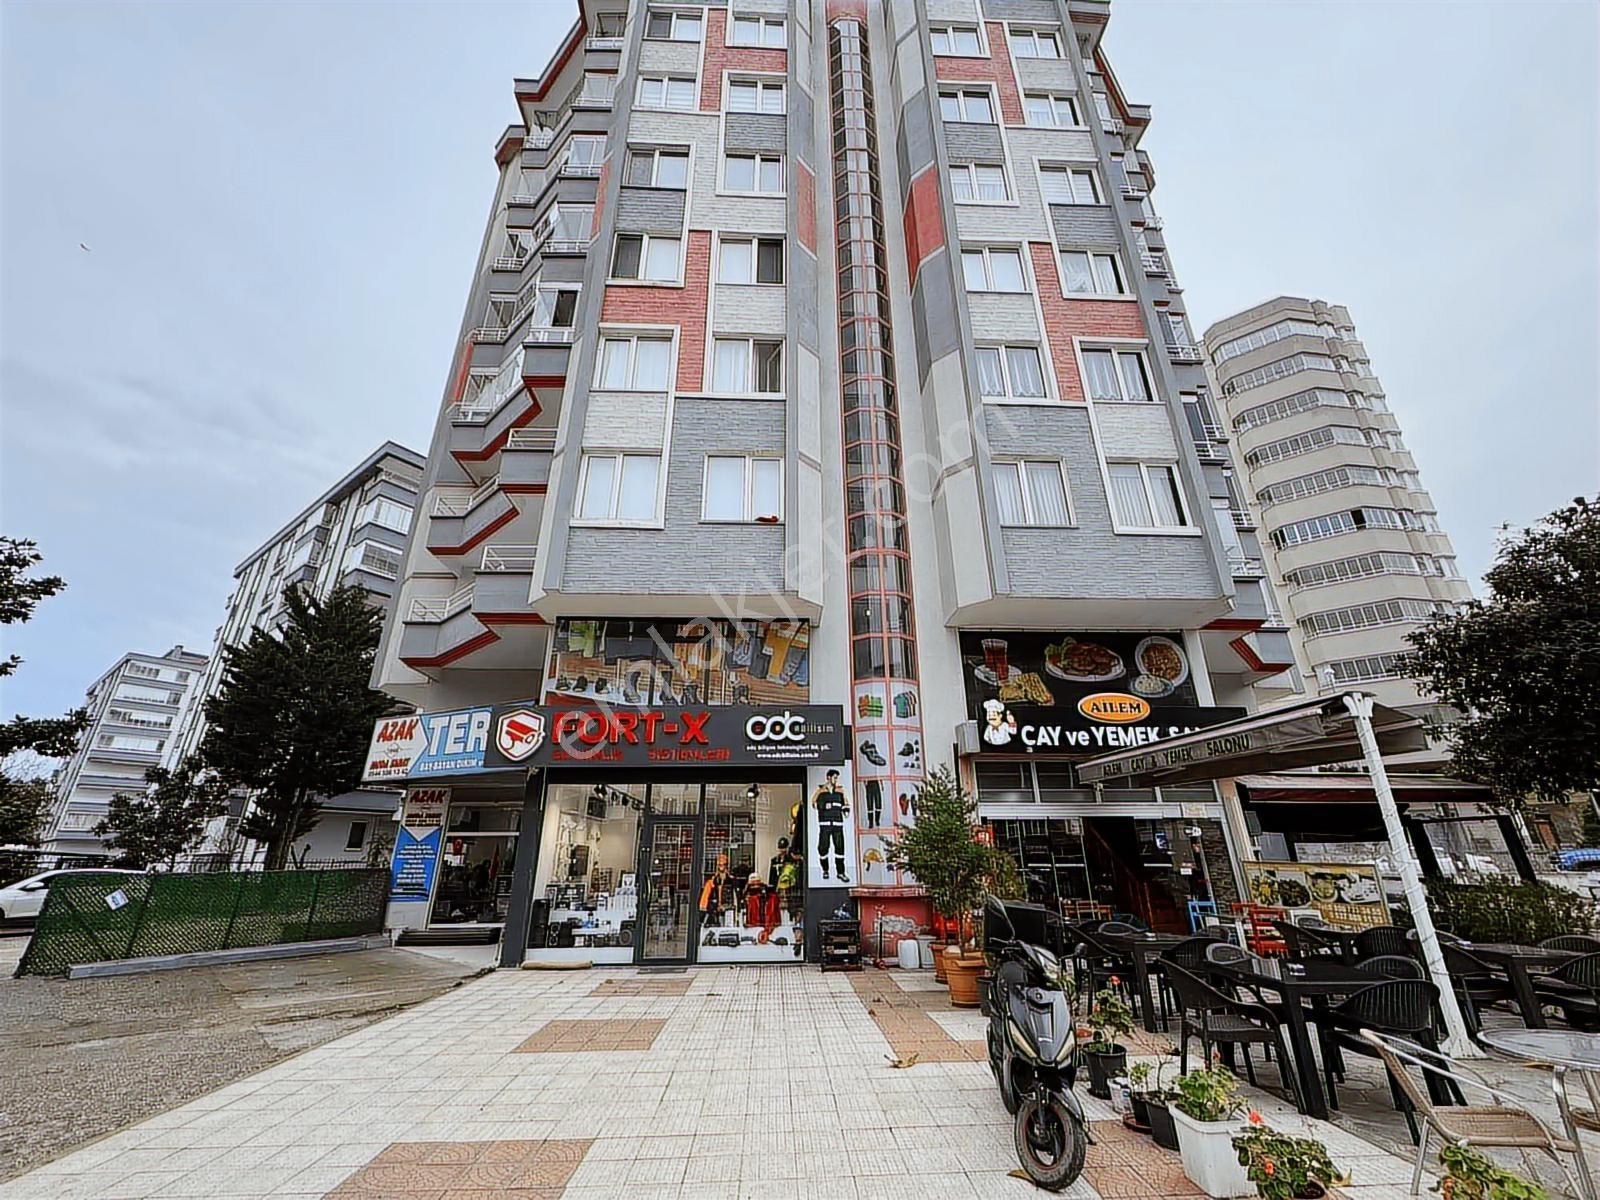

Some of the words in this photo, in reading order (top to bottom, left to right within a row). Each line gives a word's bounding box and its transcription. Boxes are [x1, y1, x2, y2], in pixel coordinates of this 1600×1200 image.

[377, 719, 419, 743] AZAK
[429, 711, 491, 756] TER
[552, 711, 711, 744] FORT-X
[1021, 725, 1062, 753] ÇAY
[1065, 730, 1090, 746] ve
[1090, 726, 1161, 747] YEMEK
[1163, 746, 1195, 766] YEMEK
[1206, 733, 1252, 756] SALONU
[409, 789, 447, 803] AZAK
